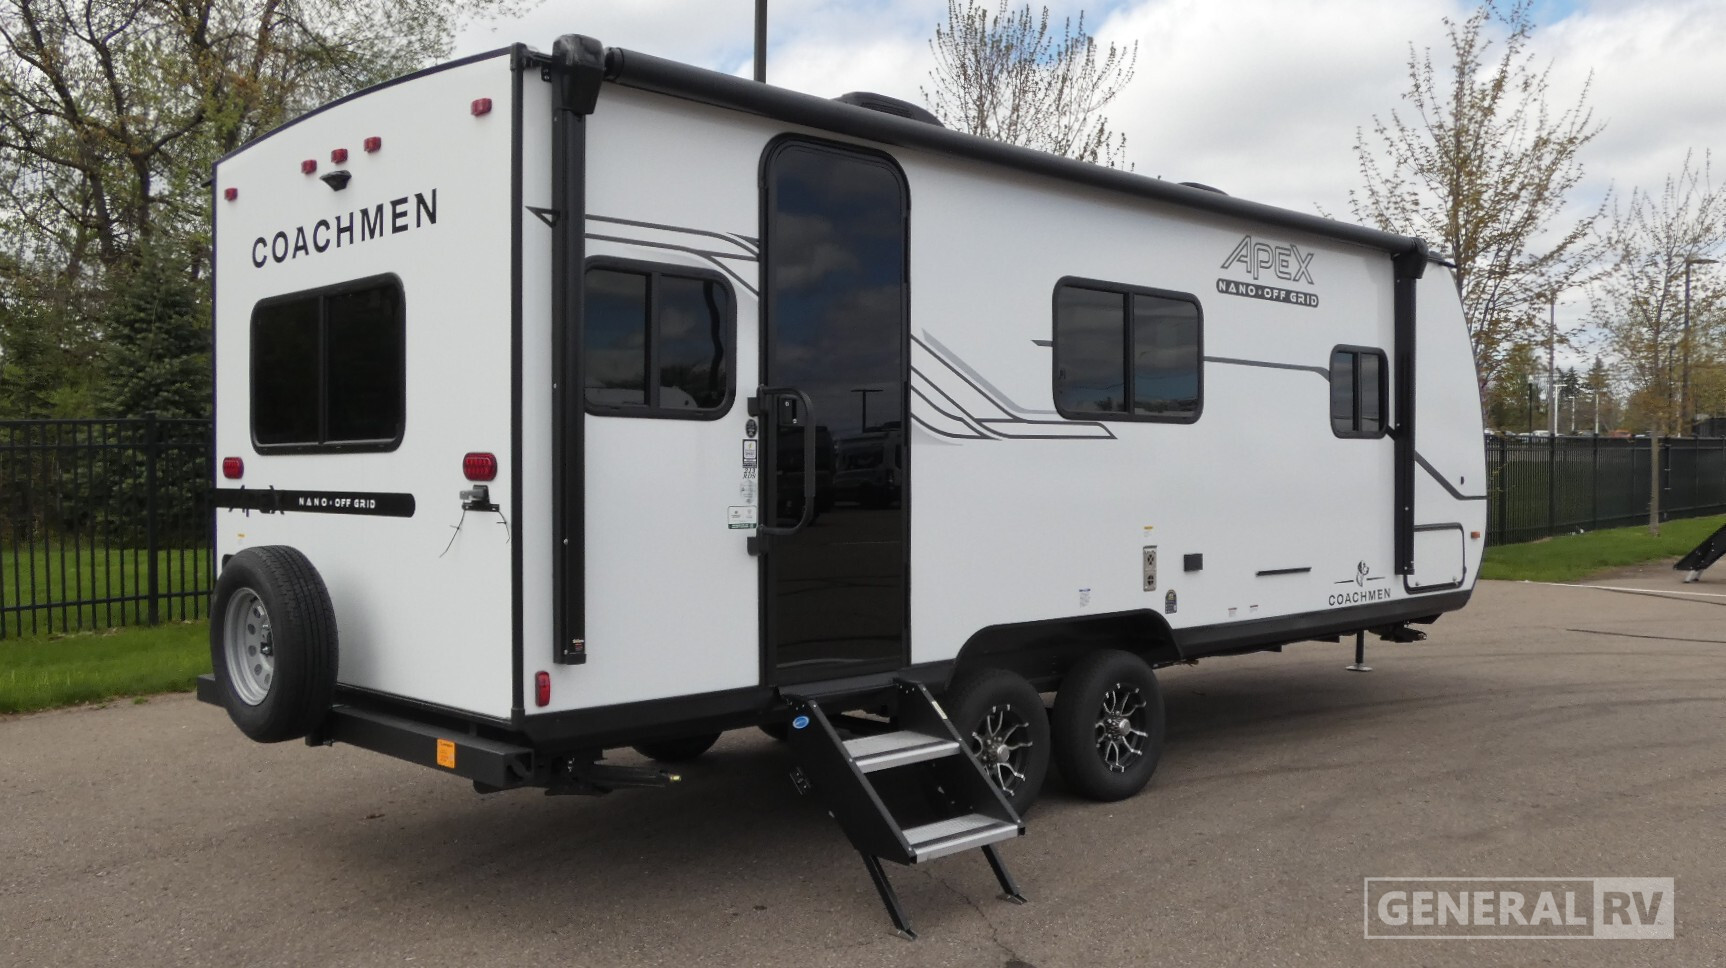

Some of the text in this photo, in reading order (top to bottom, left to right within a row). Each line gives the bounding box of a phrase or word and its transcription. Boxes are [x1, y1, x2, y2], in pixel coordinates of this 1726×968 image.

[252, 188, 437, 268] COACHMEN
[1220, 234, 1315, 285] APEX
[1218, 280, 1318, 306] NANO OFF GRID
[299, 497, 376, 509] NANO OFF GRID
[1328, 588, 1391, 606] COACHMEN
